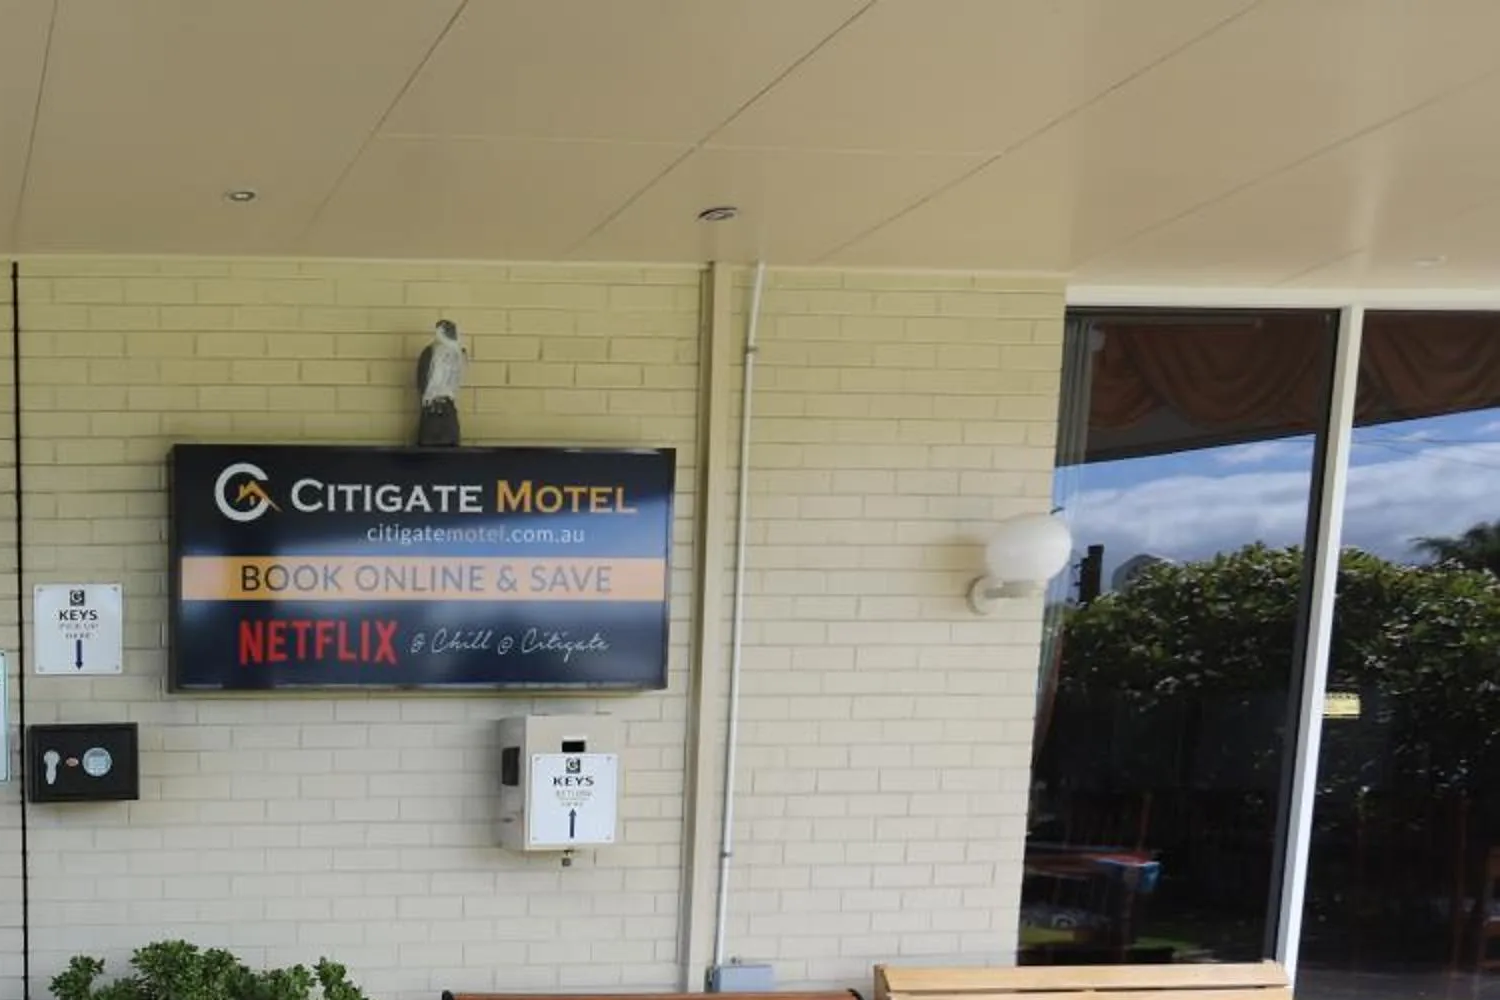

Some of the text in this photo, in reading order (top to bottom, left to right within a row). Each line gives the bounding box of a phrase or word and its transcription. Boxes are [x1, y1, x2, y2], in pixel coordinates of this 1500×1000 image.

[291, 478, 483, 513] CITIGATE
[496, 479, 638, 514] MOTEL
[367, 523, 586, 546] citigatemotel.com.au
[240, 564, 613, 592] BOOK ONLINE & SAVE
[59, 609, 98, 620] KEYS
[239, 620, 397, 665] NETFLIX
[431, 627, 490, 654] Chill
[520, 627, 611, 663] Citigate
[553, 776, 594, 787] KEYS
